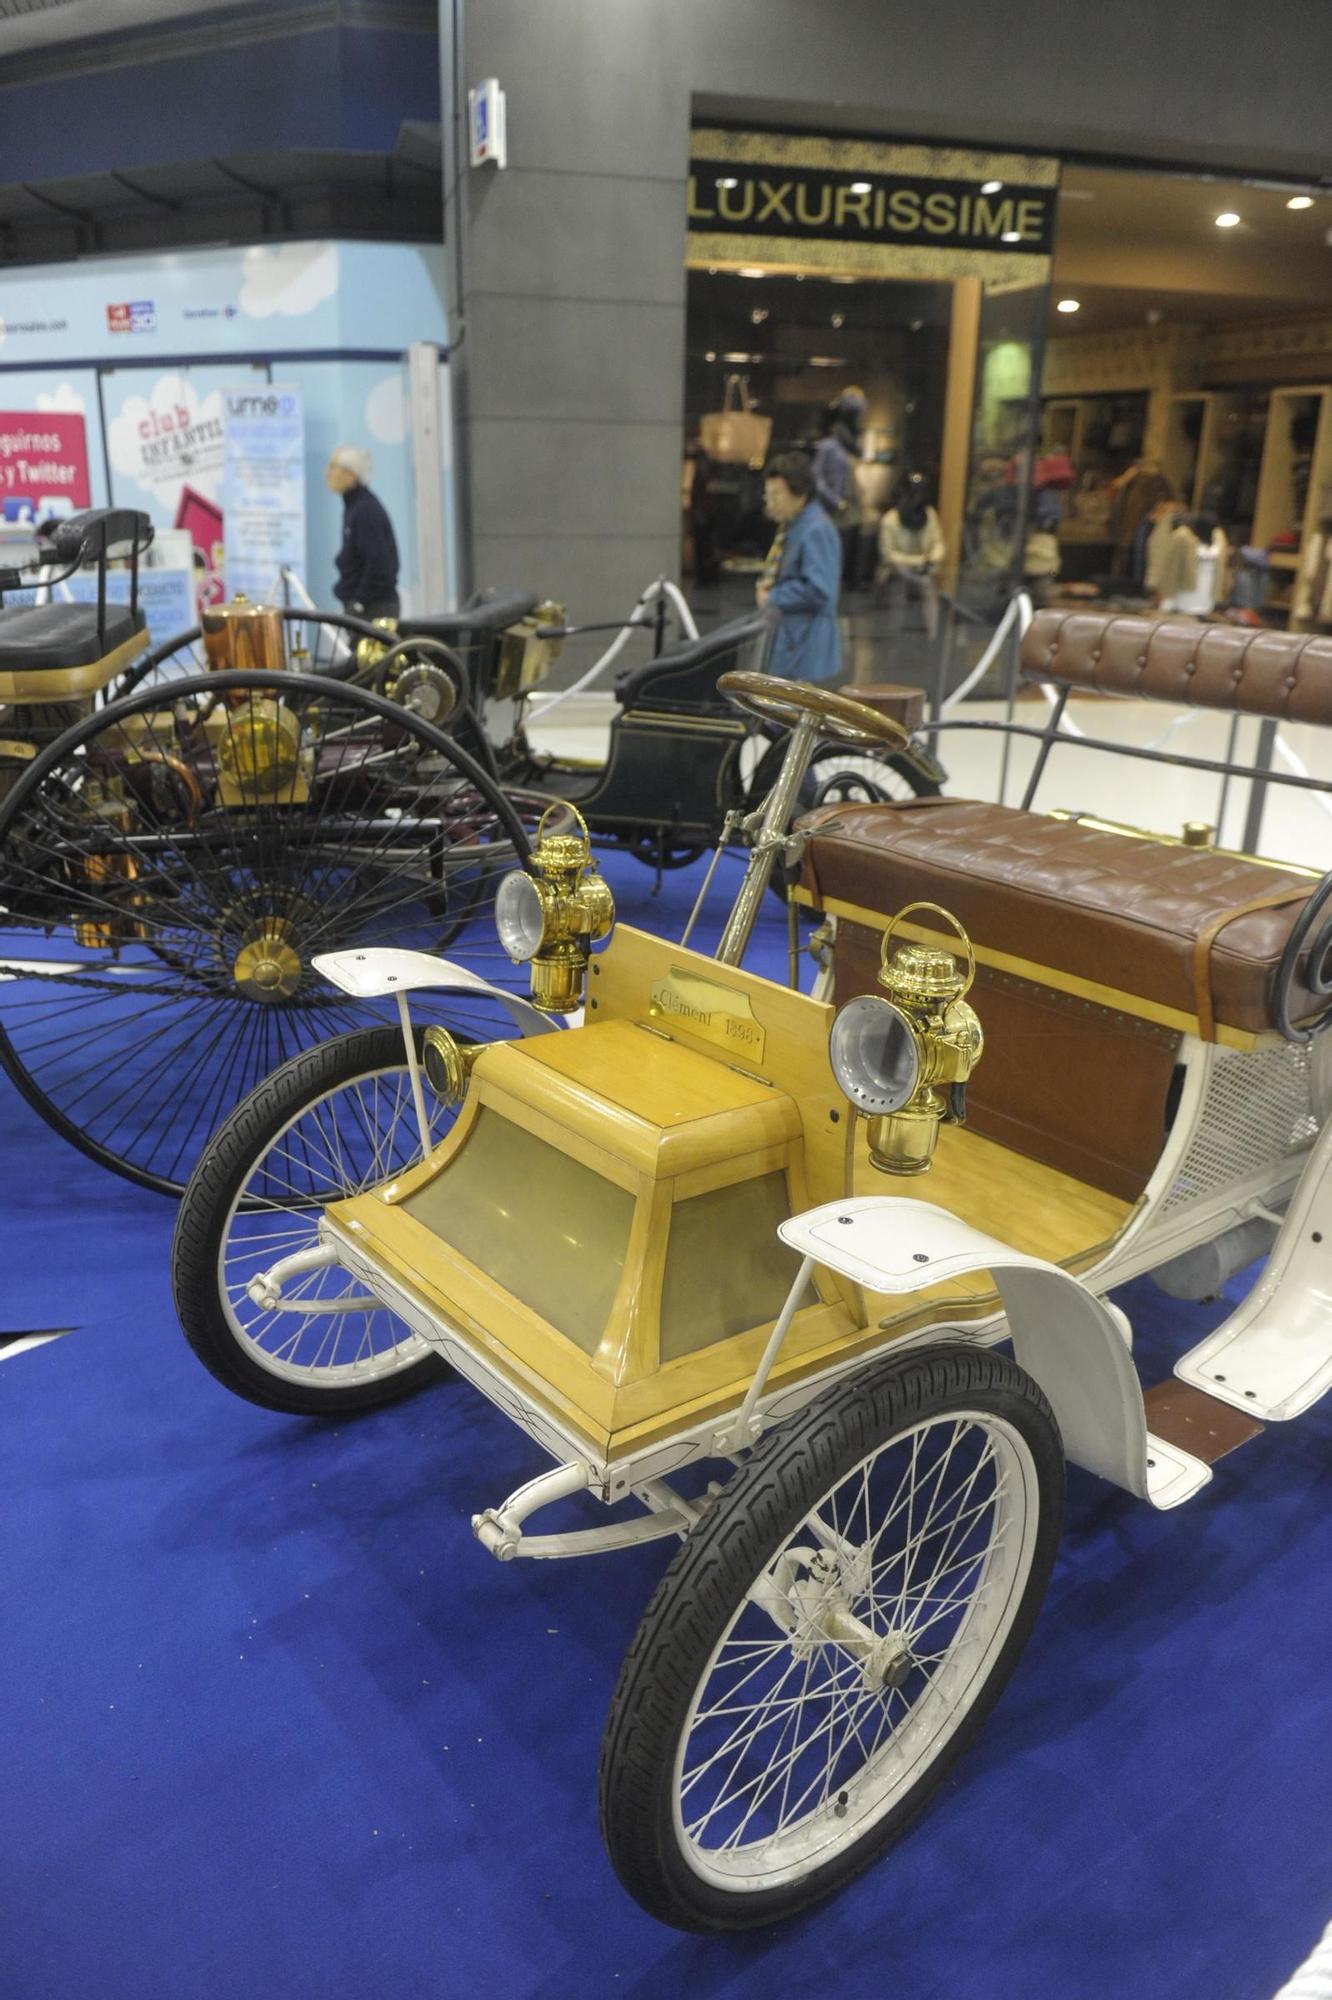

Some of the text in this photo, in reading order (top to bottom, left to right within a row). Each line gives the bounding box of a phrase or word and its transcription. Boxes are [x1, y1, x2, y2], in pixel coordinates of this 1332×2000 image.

[687, 177, 1043, 241] LUXURISSIME
[138, 403, 190, 438] club
[5, 465, 15, 488] y
[17, 460, 76, 485] Twitter
[659, 989, 712, 1026] Clément
